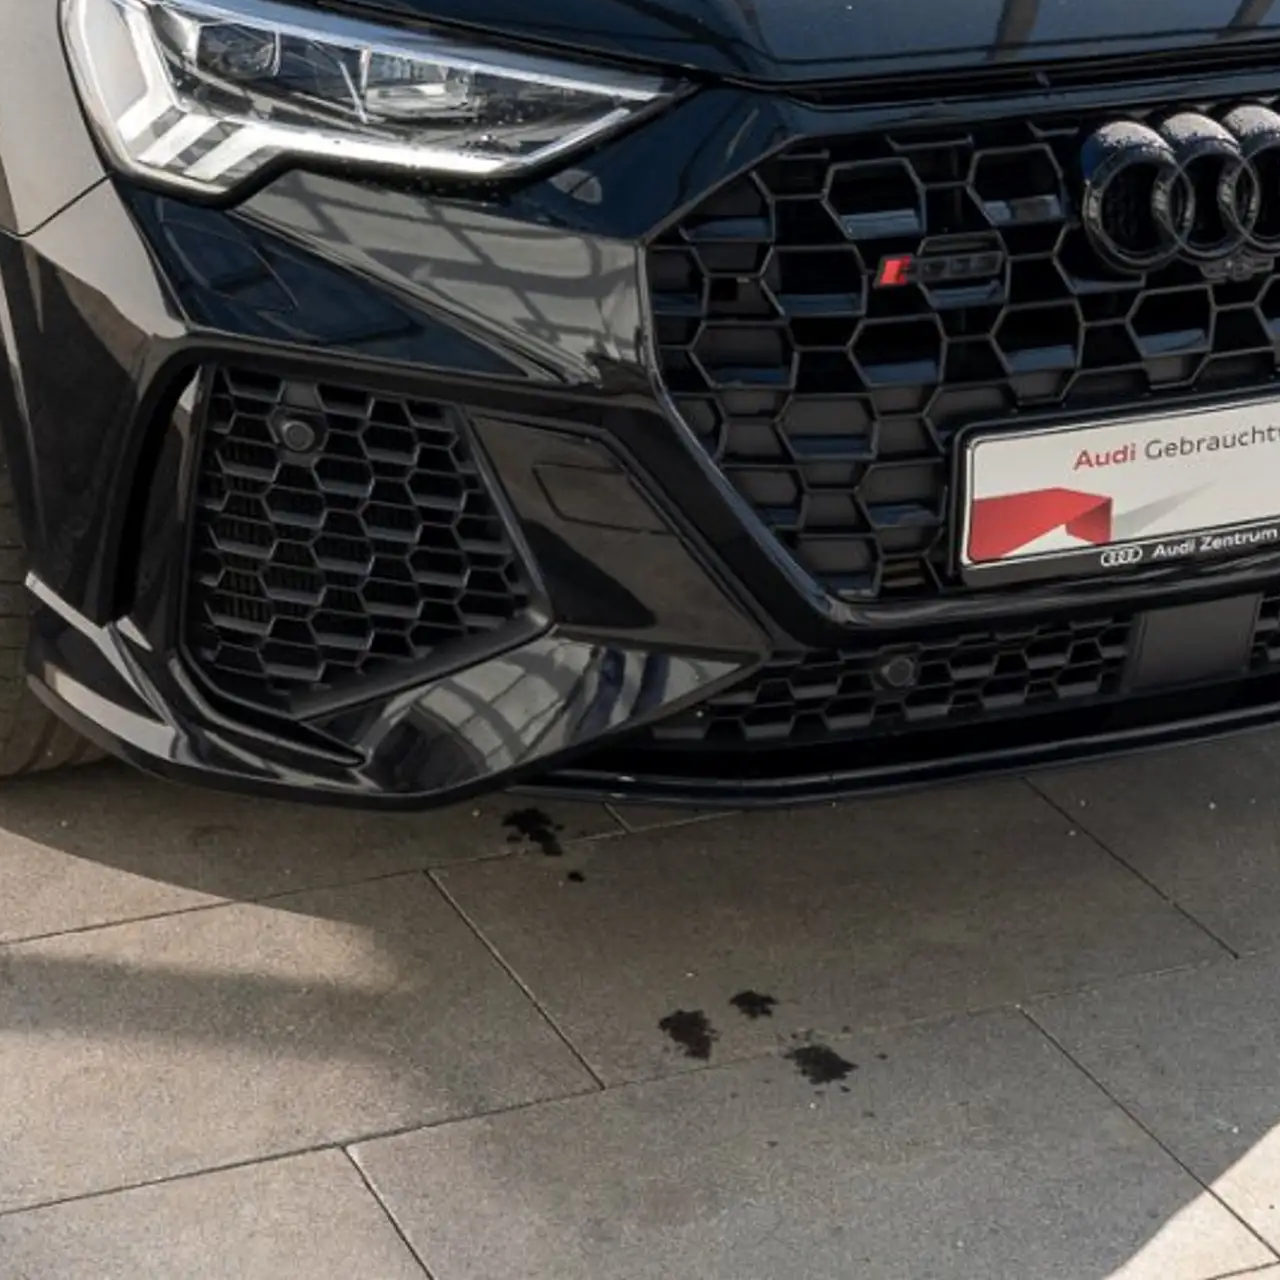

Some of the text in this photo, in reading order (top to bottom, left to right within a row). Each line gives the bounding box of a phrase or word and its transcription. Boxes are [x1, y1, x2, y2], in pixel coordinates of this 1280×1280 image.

[1073, 443, 1136, 470] Audi
[1152, 538, 1195, 559] Audi
[1200, 527, 1278, 552] Zentrum
